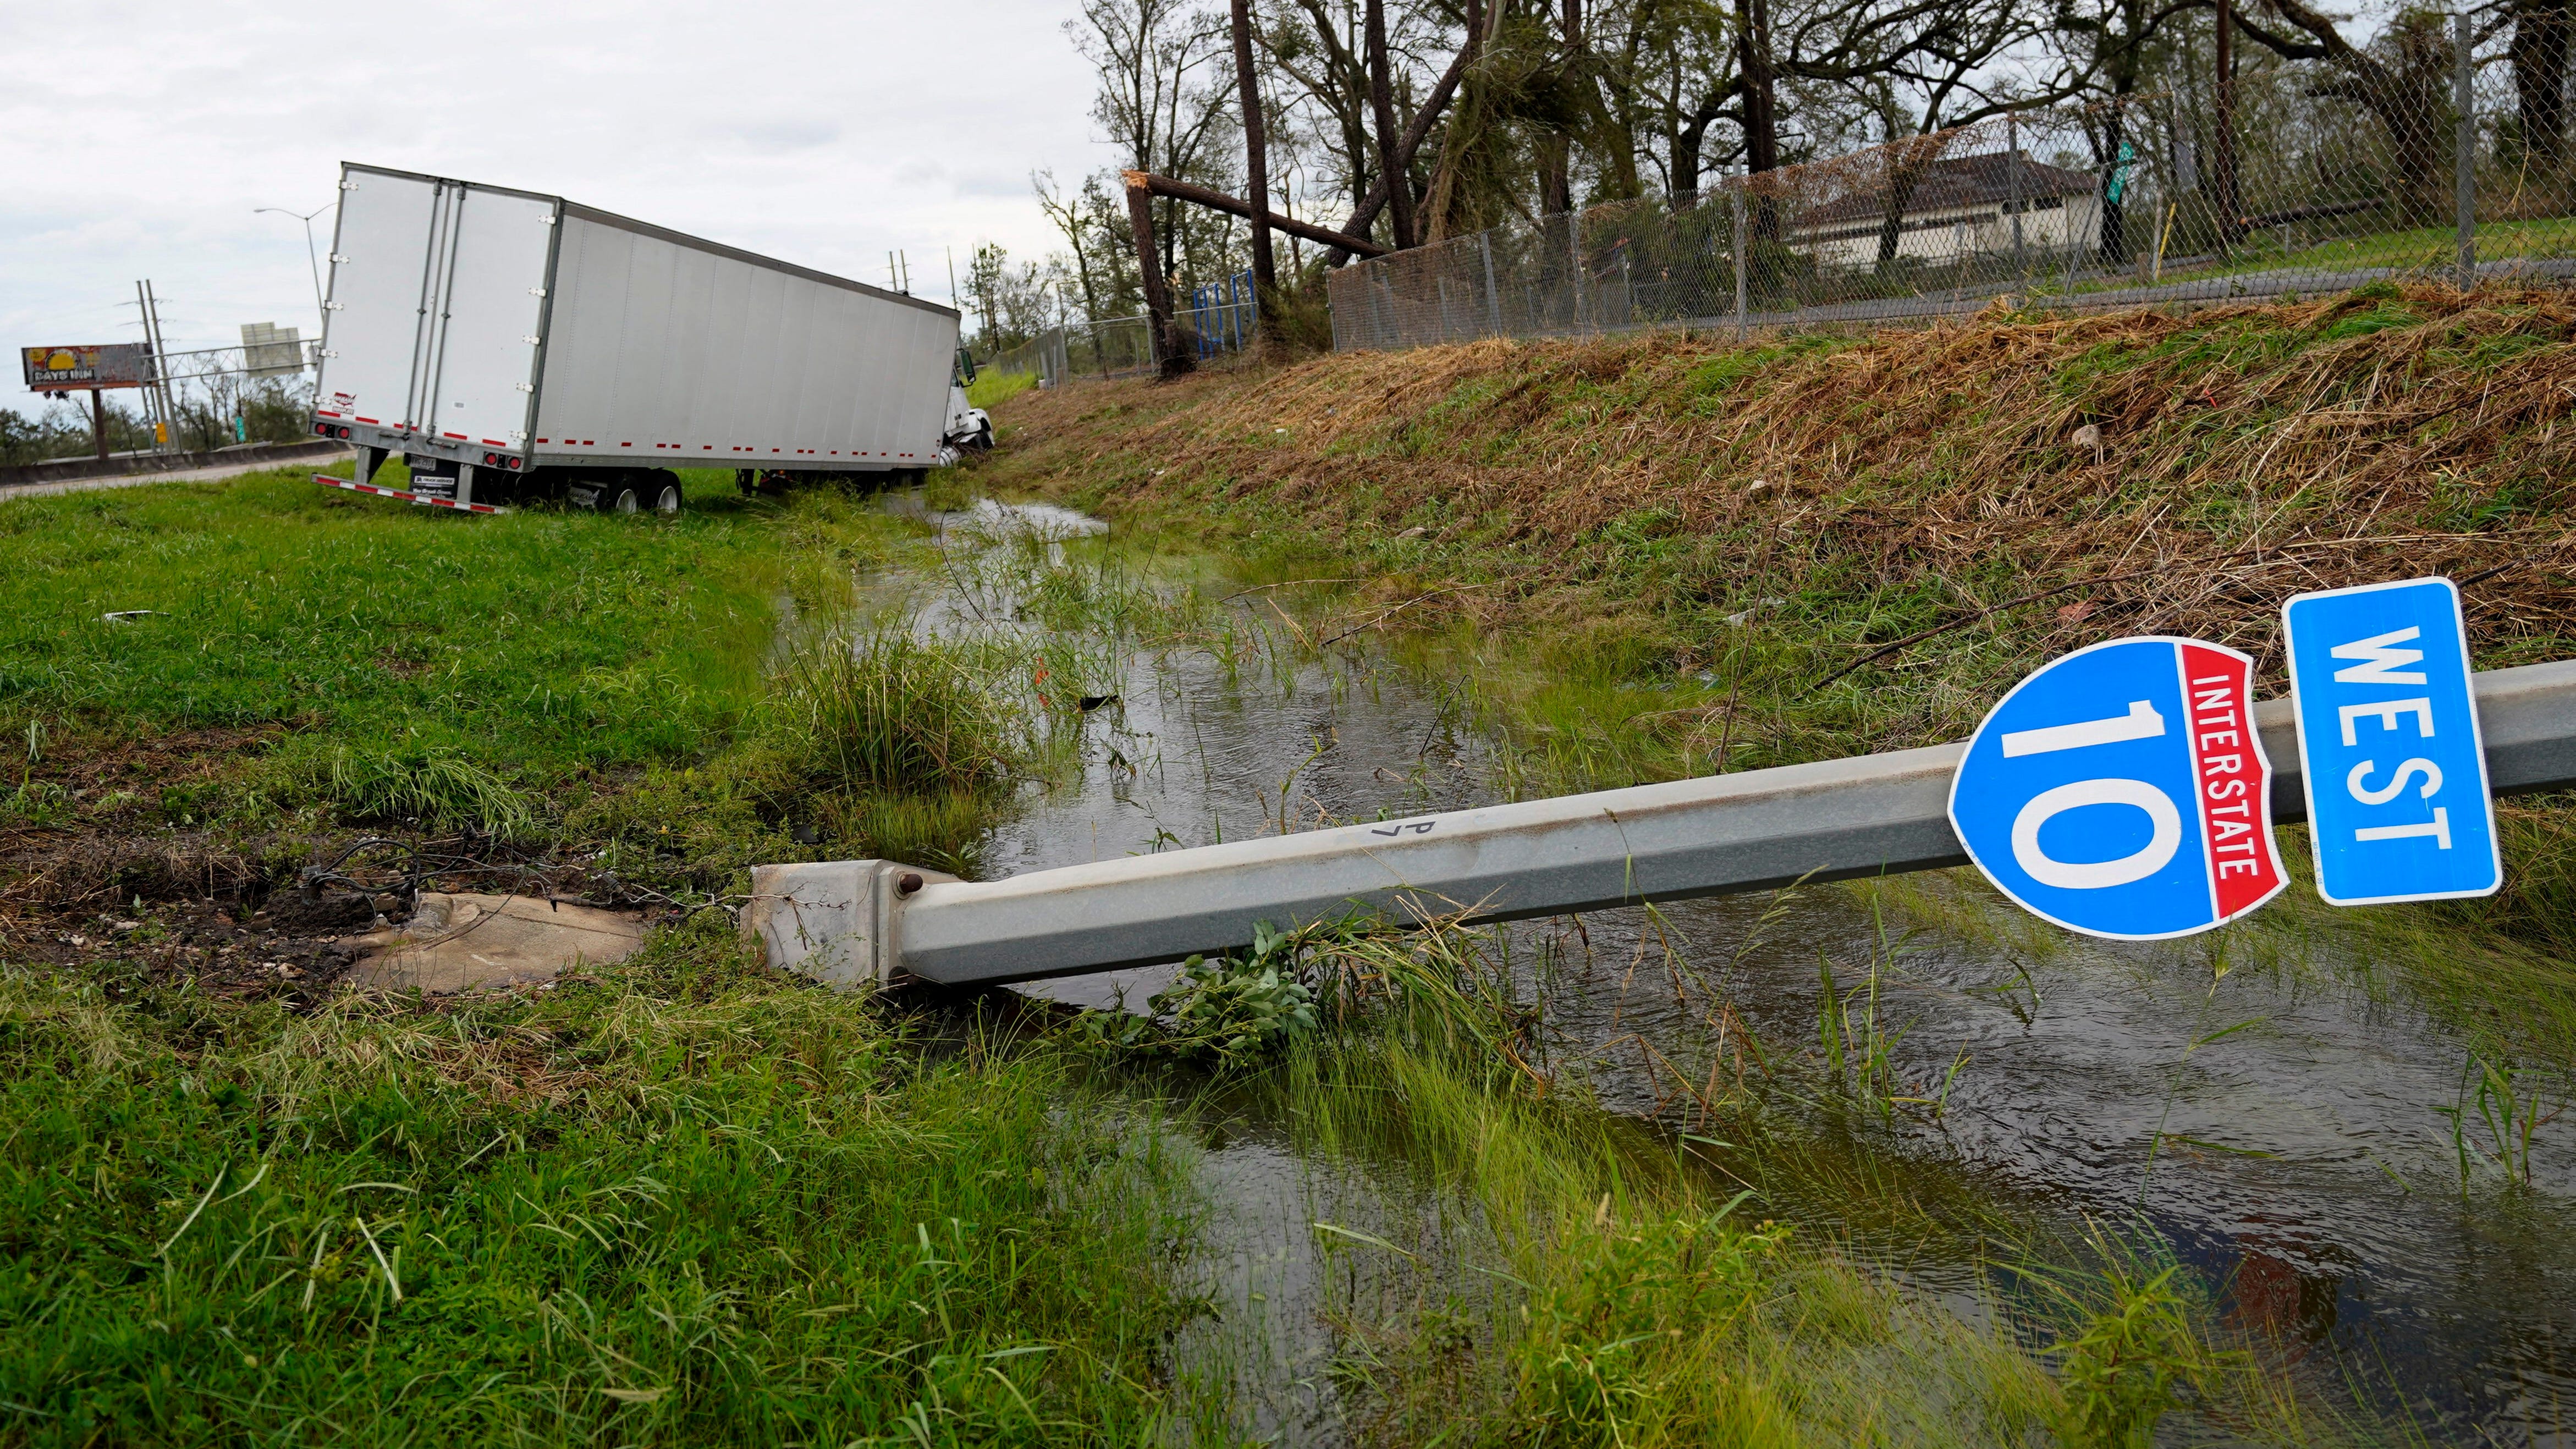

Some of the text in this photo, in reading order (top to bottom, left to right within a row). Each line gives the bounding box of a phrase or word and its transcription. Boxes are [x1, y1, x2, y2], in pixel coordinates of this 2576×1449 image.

[35, 370, 92, 381] DAYS INN
[569, 492, 598, 502] WABASH
[2001, 699, 2182, 889] 10
[2193, 675, 2258, 880] INTERSTATE
[2330, 625, 2452, 850] WEST
